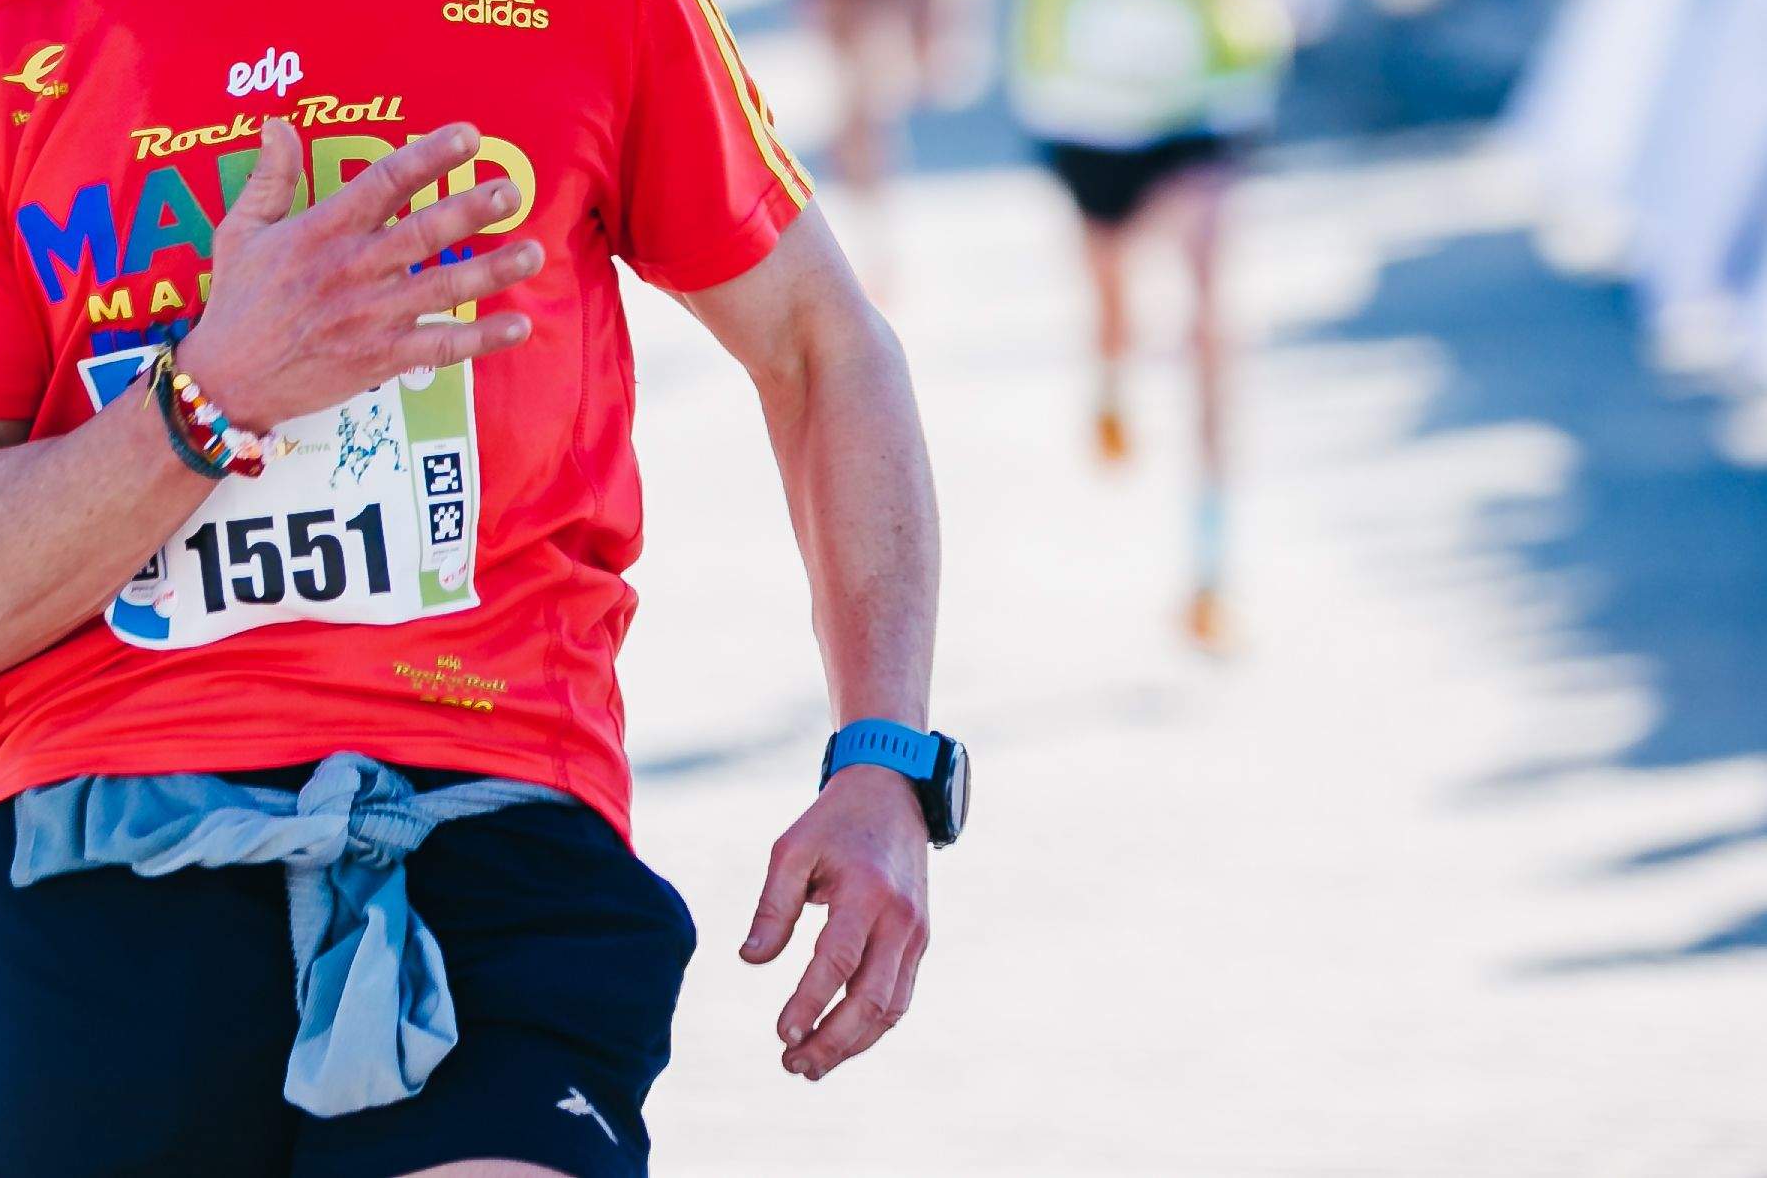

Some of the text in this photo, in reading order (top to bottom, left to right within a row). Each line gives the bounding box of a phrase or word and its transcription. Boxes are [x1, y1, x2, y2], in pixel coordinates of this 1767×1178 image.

[442, 0, 550, 29] adidas
[227, 47, 304, 98] edp
[130, 113, 263, 160] Rock
[297, 95, 406, 128] Roll
[184, 502, 392, 615] 1551
